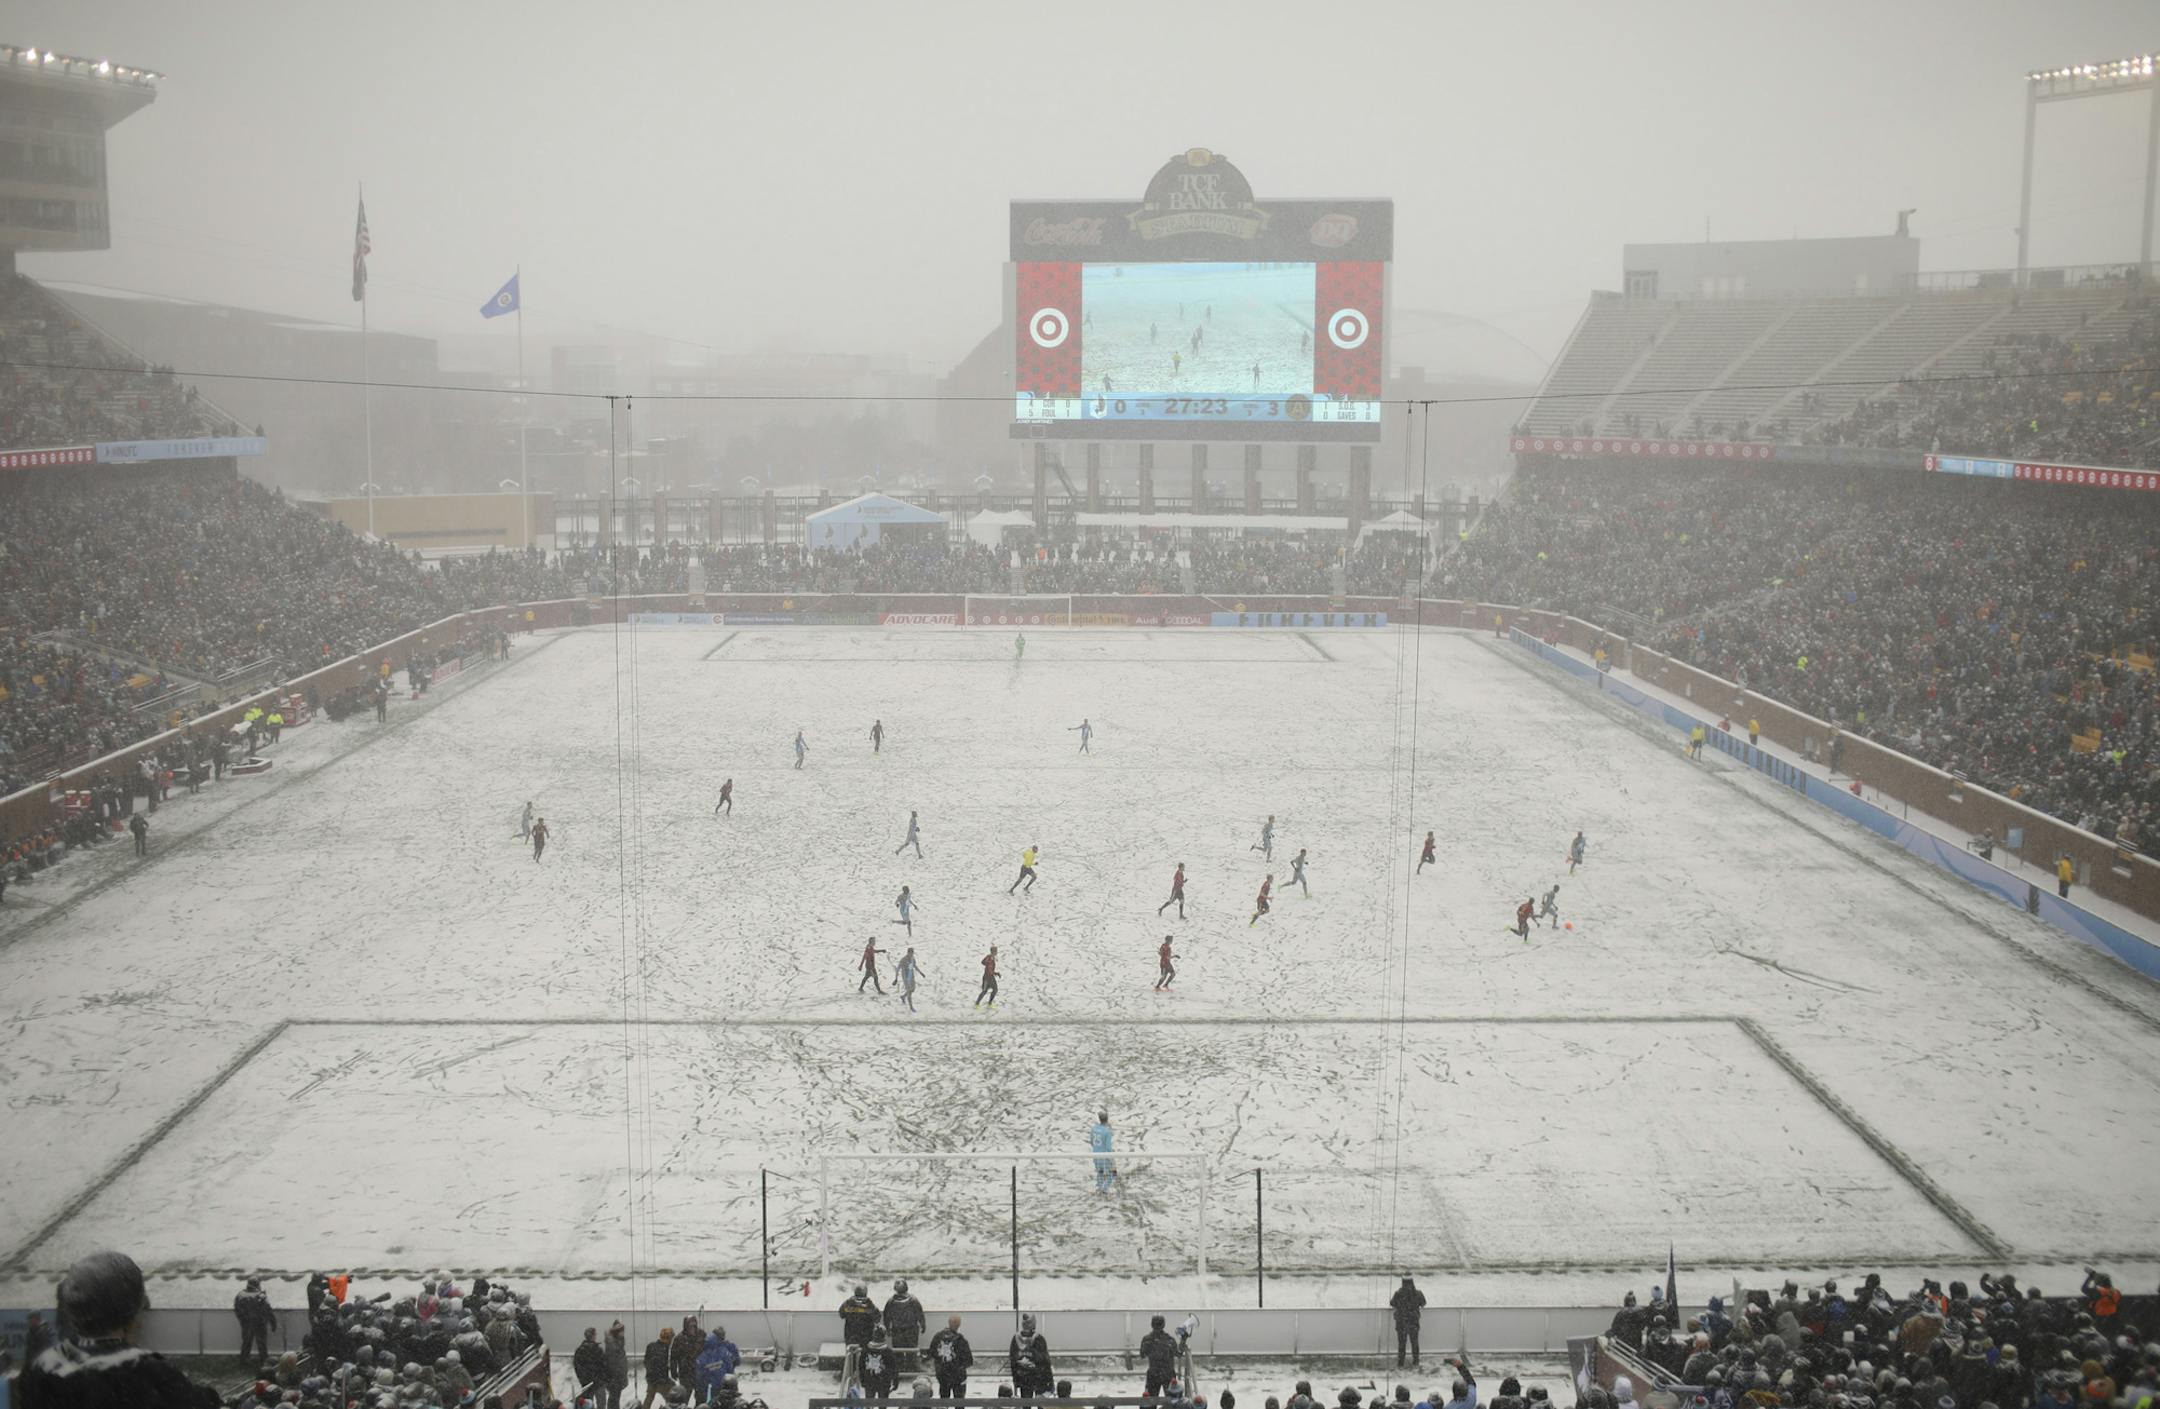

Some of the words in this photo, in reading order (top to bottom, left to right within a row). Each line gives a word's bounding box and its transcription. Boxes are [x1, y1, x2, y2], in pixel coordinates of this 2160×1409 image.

[1178, 174, 1221, 192] TCF
[1168, 192, 1227, 210] BANK
[1114, 399, 1127, 415] 0
[1164, 398, 1229, 416] 27:23
[1267, 400, 1279, 416] 3
[886, 614, 957, 625] ADVOCARE
[1135, 616, 1159, 625] Audi
